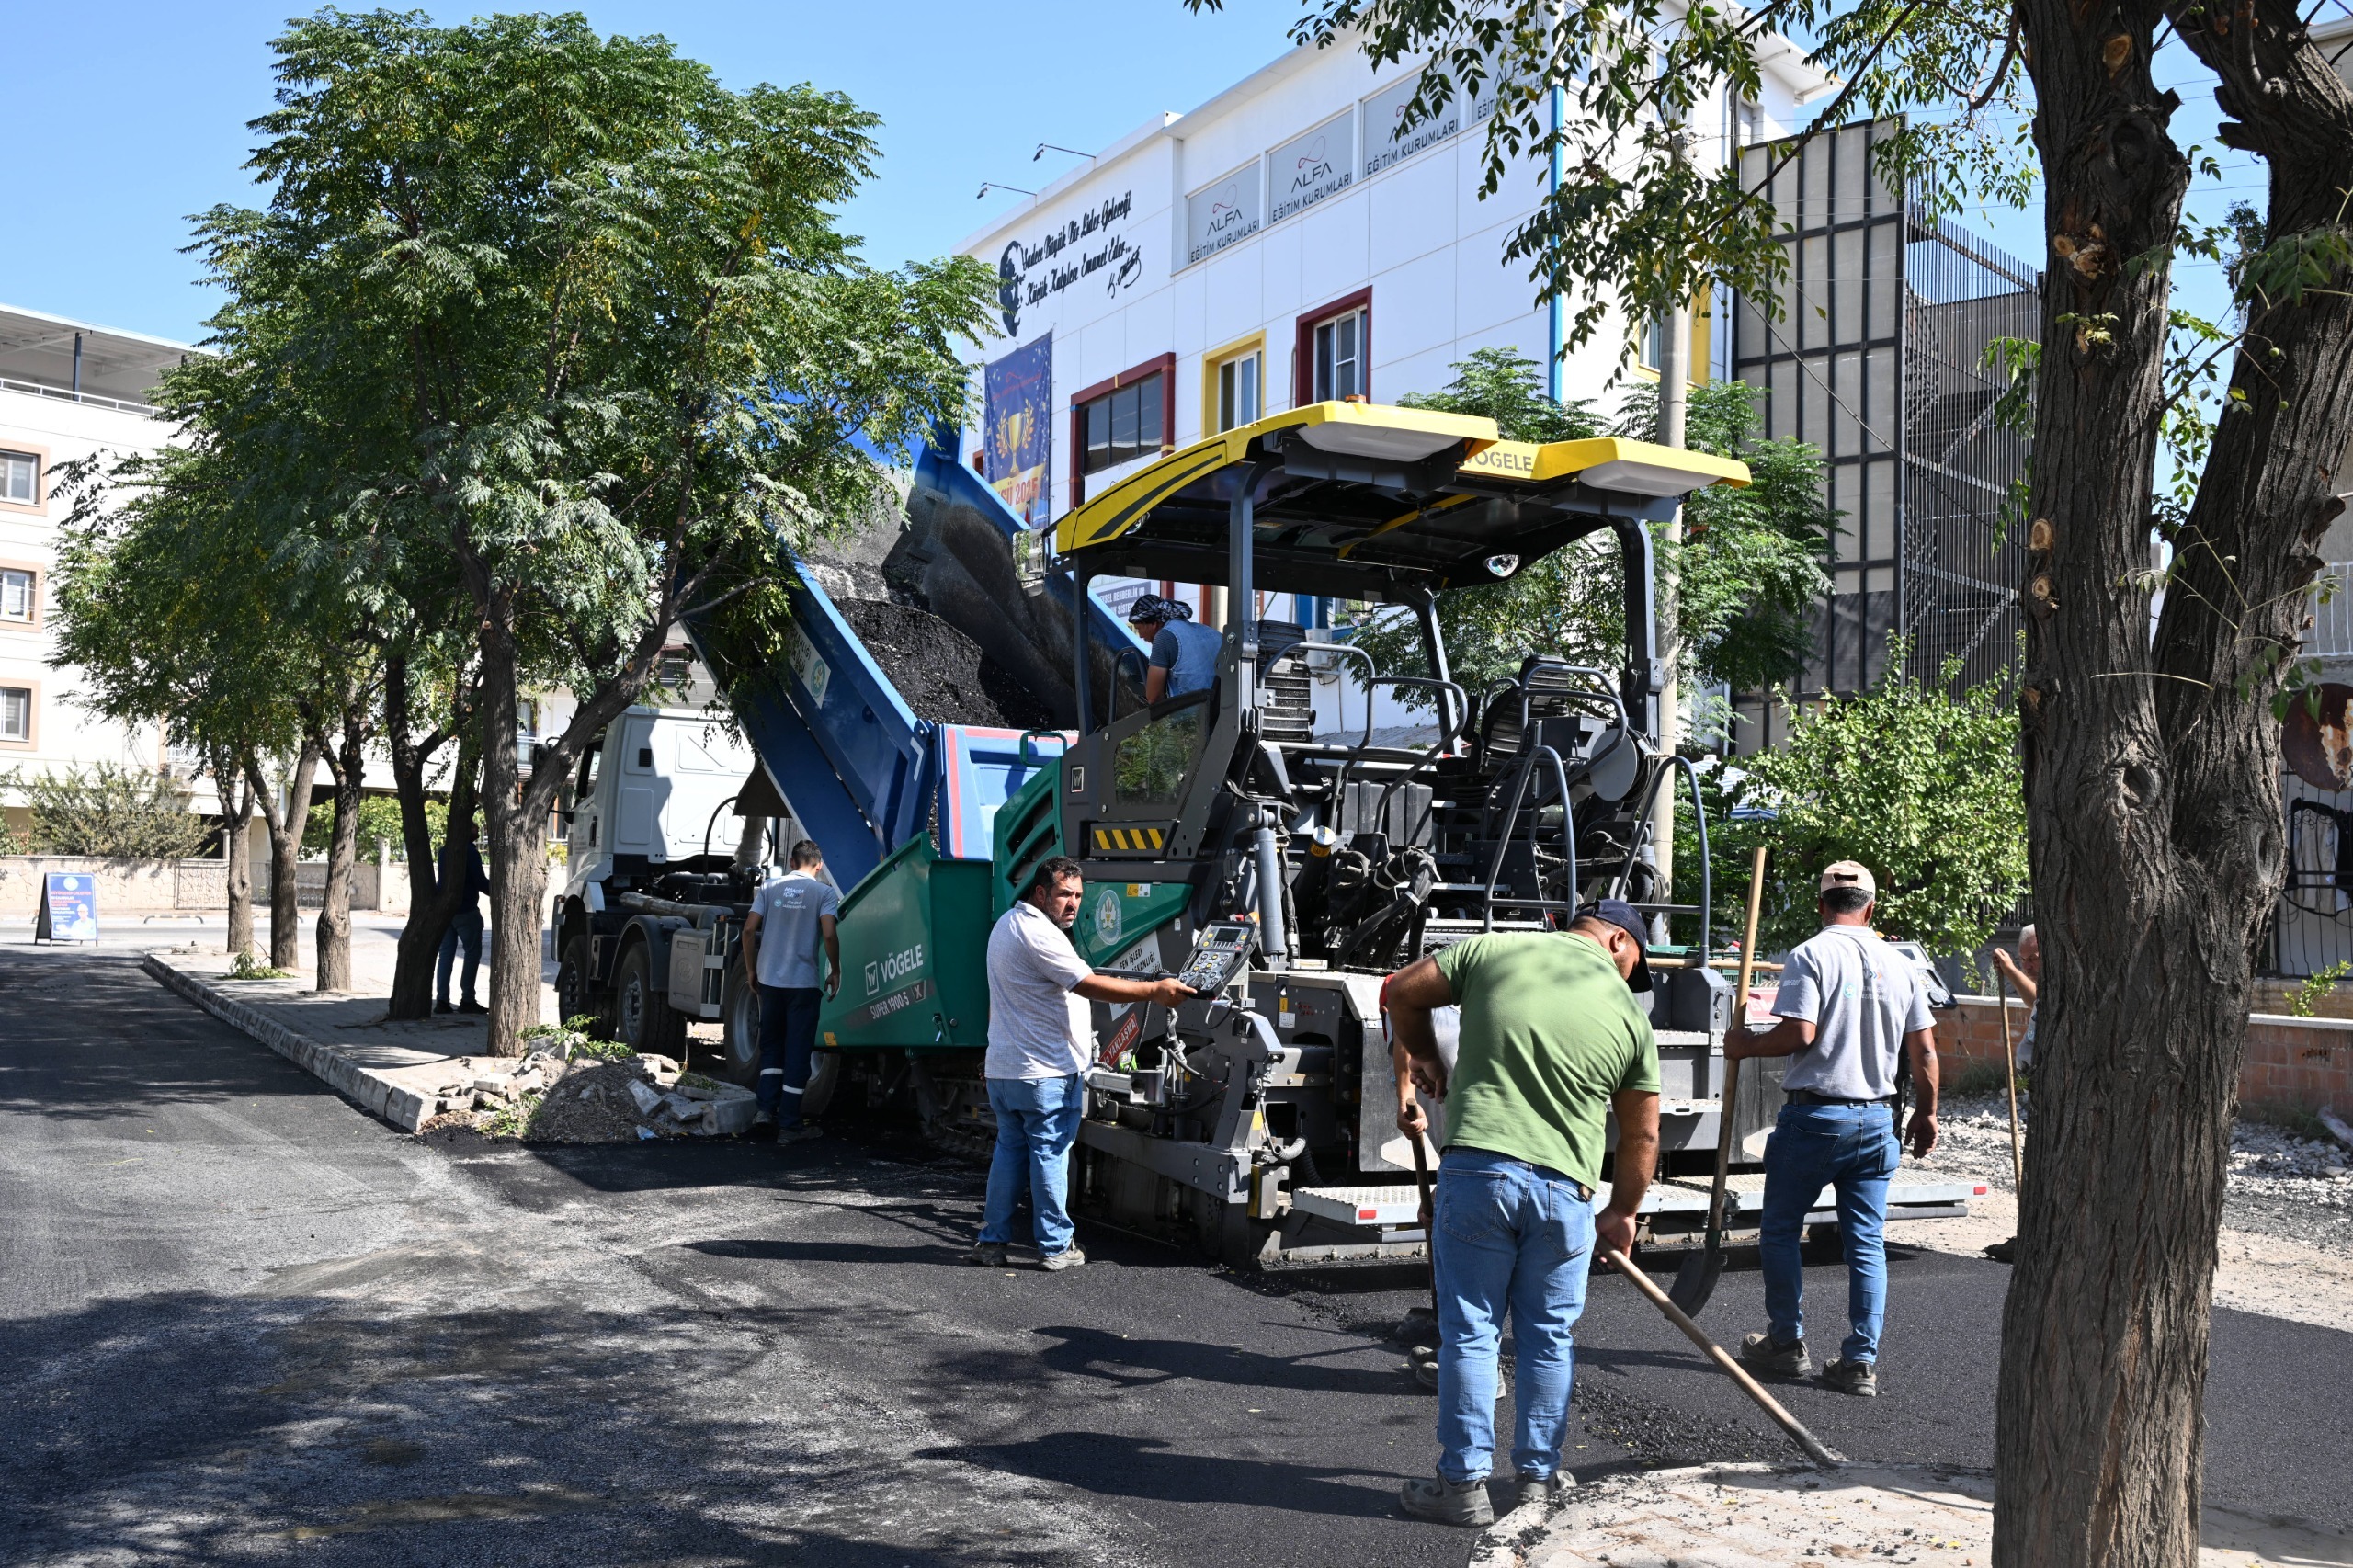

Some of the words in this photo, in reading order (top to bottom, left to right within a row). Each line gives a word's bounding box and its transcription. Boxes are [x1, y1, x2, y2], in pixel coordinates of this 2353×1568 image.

[1367, 149, 1398, 175] EĞİTİM
[1401, 119, 1459, 158] KURUMLARI
[1291, 162, 1332, 193] ALFA
[1273, 198, 1300, 222] EĞİTİM
[1302, 172, 1352, 207] KURUMLARI
[1068, 220, 1080, 245] Bir
[1081, 208, 1101, 238] Lider
[1207, 208, 1243, 236] ALFA
[1190, 240, 1215, 263] EĞİTİM
[1217, 219, 1260, 250] KURUMLARI
[1015, 476, 1039, 505] 2025
[881, 943, 924, 983] VÖGELE
[1120, 958, 1129, 970] FEN
[870, 1004, 891, 1020] SUPER
